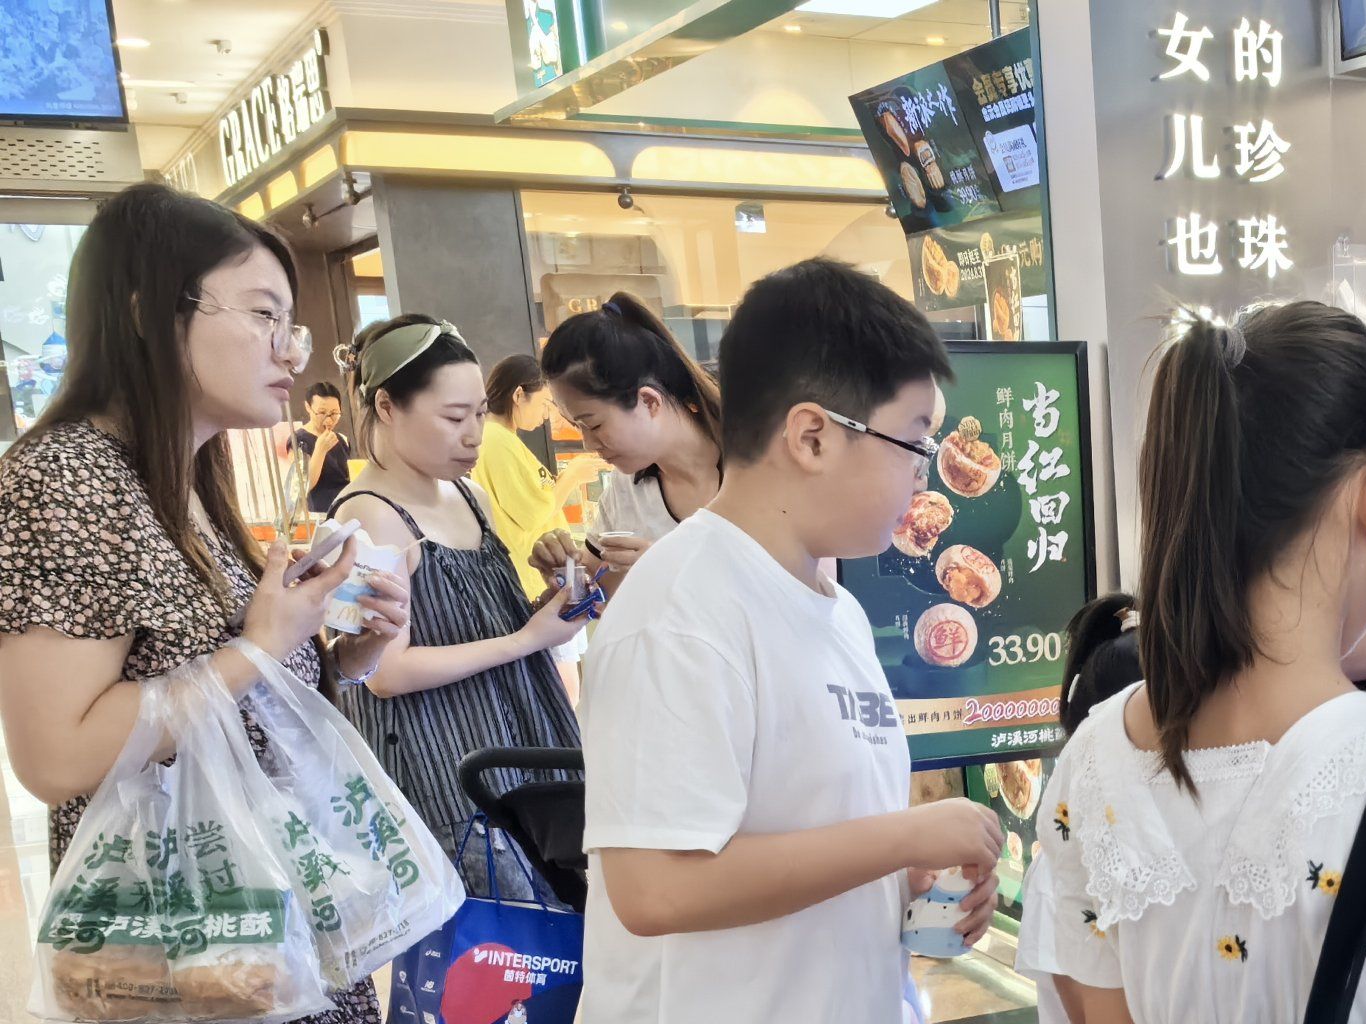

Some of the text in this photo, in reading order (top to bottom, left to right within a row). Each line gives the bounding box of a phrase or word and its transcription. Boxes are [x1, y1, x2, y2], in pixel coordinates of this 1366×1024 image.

[1154, 12, 1224, 279] 女儿也
[996, 386, 1018, 473] 鲜肉月饼
[1016, 381, 1071, 574] 当红回归
[987, 632, 1061, 667] 33.90
[487, 952, 579, 975] INTERSPORT
[503, 969, 548, 986] 茵特体育
